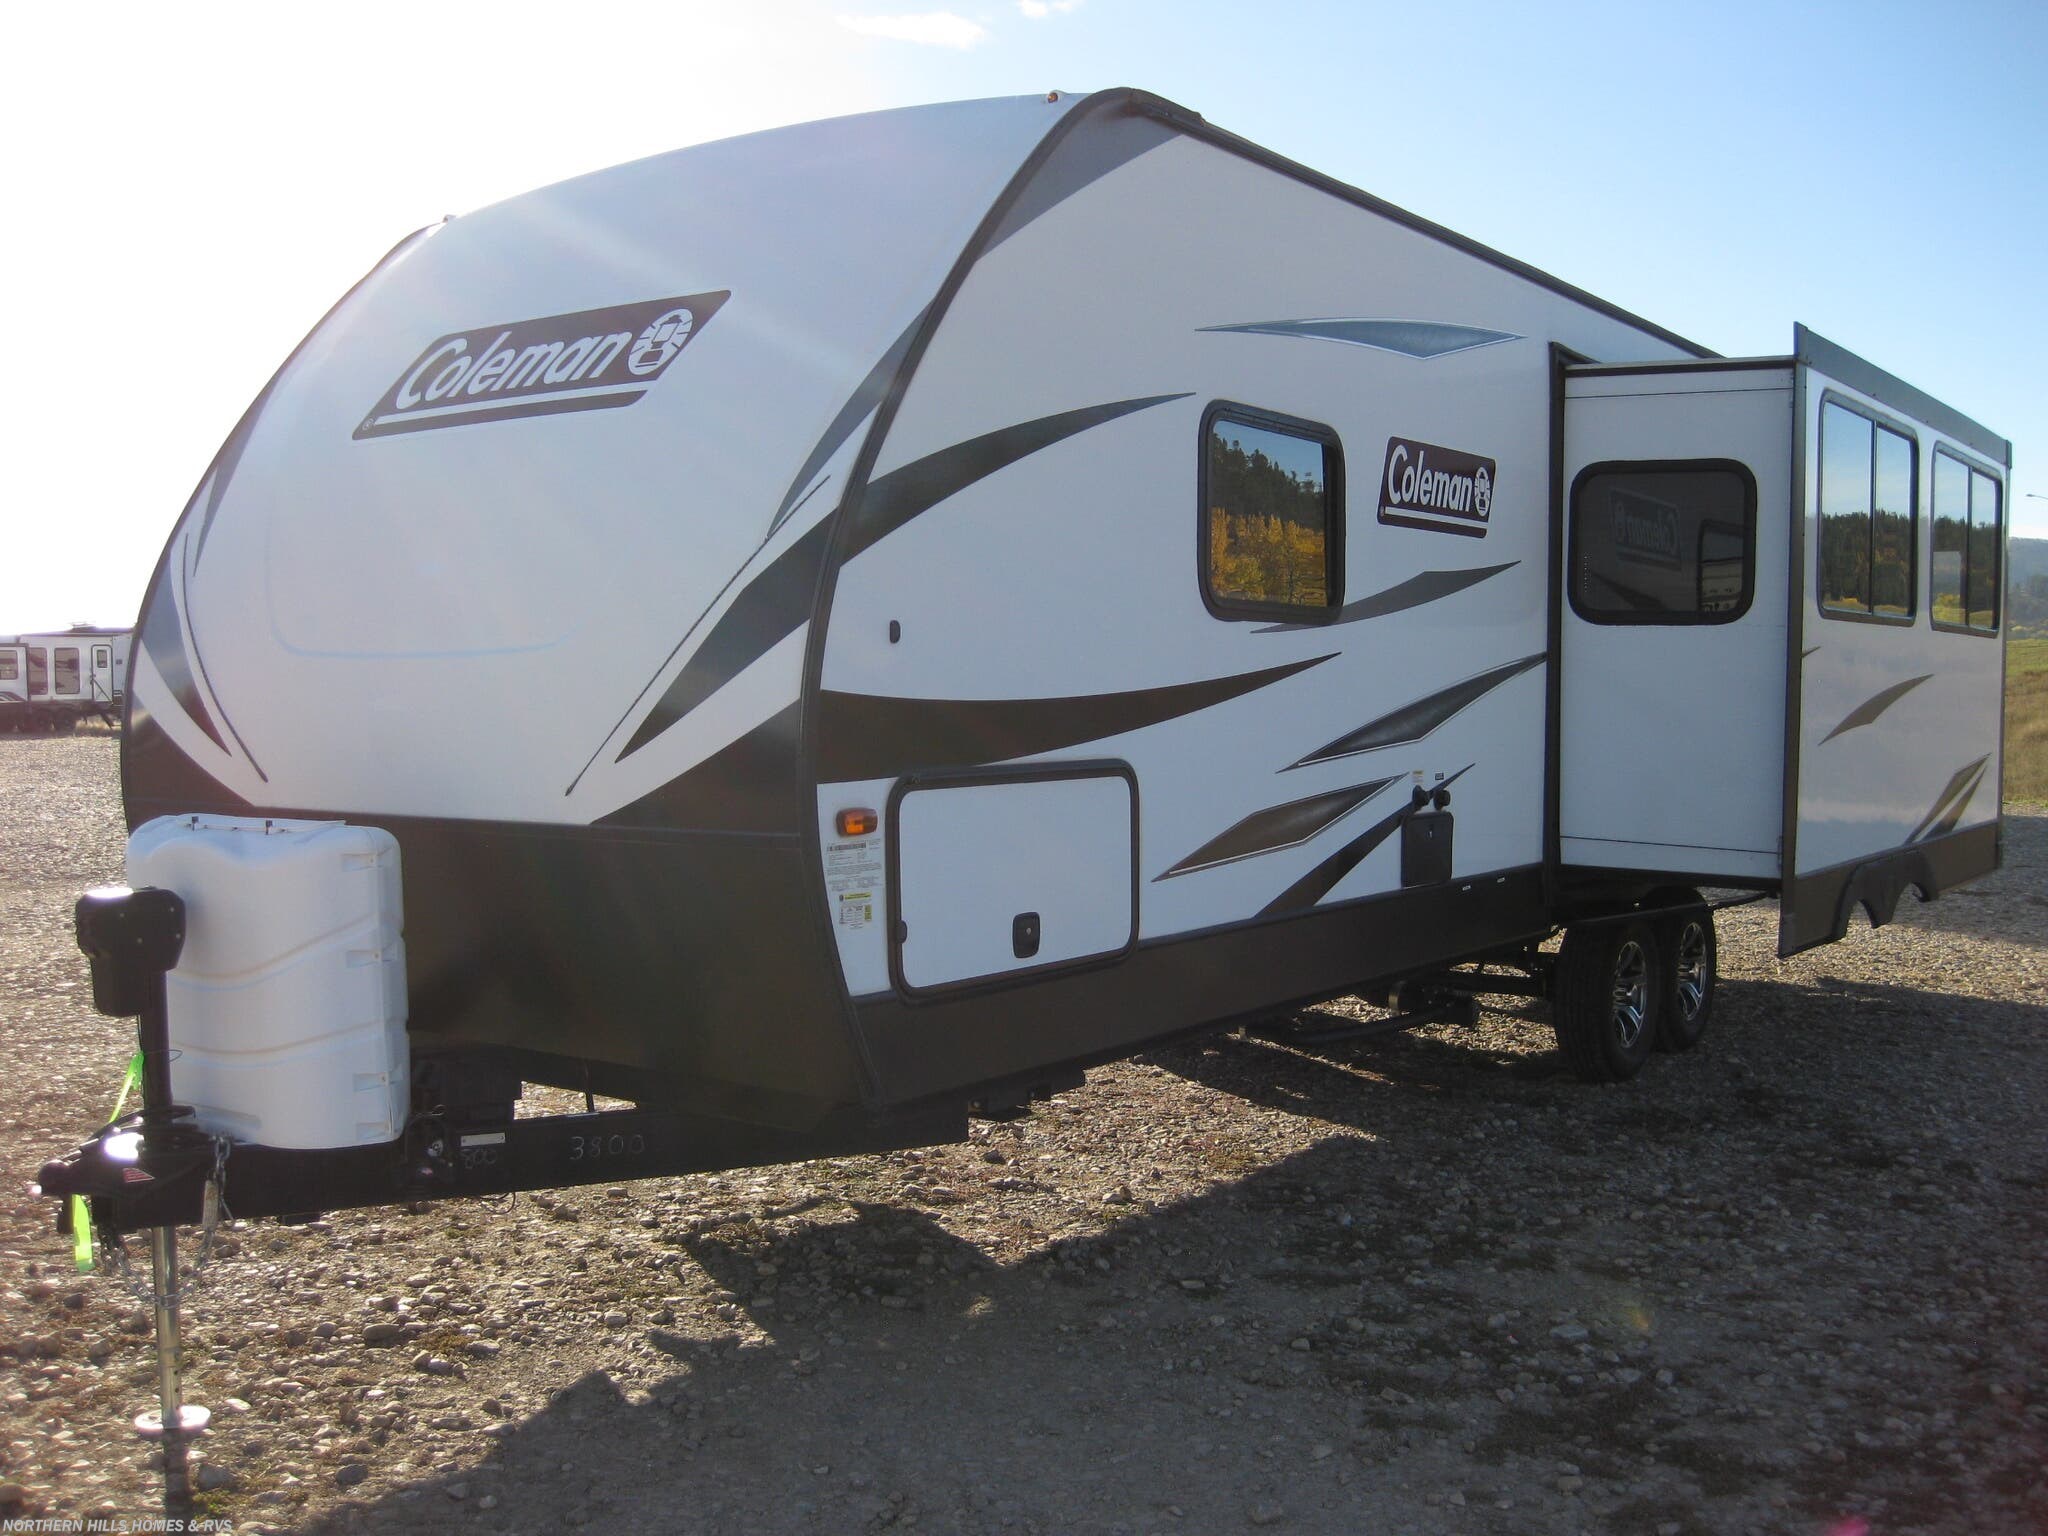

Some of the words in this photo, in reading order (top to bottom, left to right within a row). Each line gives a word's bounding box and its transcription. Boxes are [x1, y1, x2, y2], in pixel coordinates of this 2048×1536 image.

[396, 331, 632, 410] Coleman
[1387, 444, 1473, 512] Coleman
[569, 1134, 645, 1161] 3800
